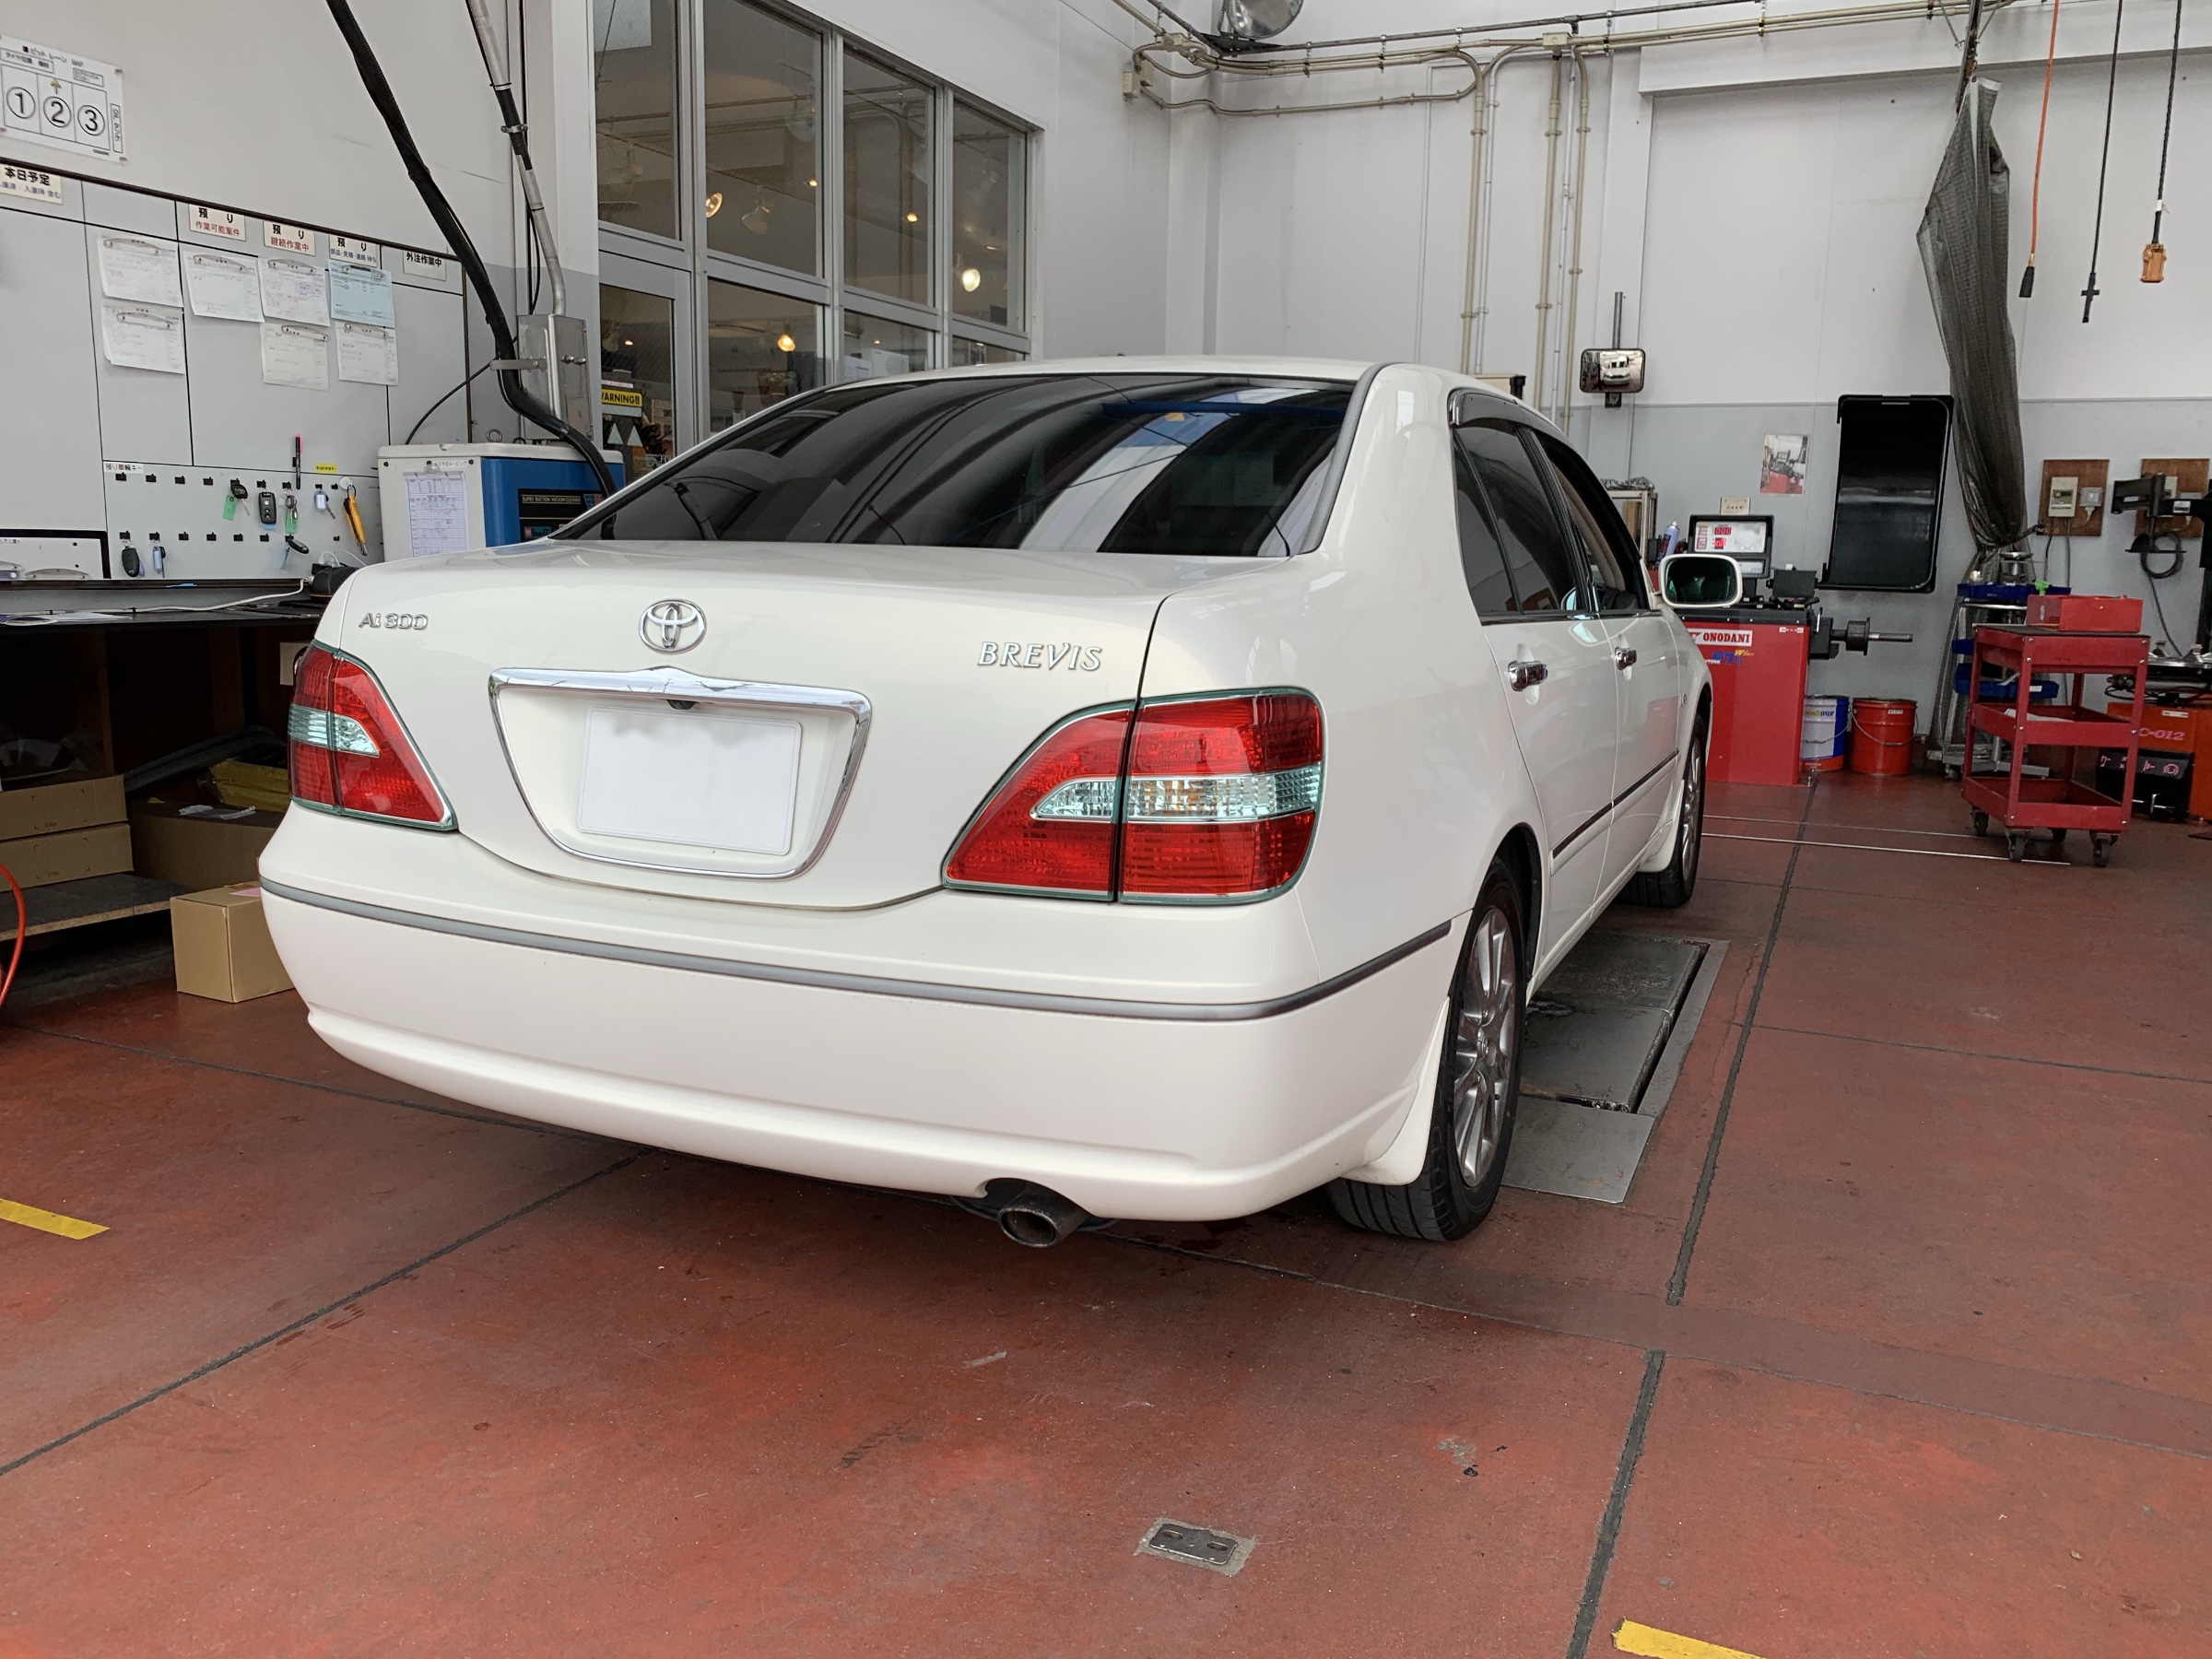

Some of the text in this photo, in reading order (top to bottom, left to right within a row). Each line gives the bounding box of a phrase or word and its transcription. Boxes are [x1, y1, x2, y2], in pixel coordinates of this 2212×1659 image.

[5, 167, 50, 186] 本日予定
[195, 220, 241, 238] 作業可能案件
[270, 236, 310, 253] 継続作業中
[406, 251, 442, 268] 外注作業中
[383, 613, 429, 631] 300
[1702, 632, 1750, 644] ONODANI
[977, 641, 1103, 672] BREVIS
